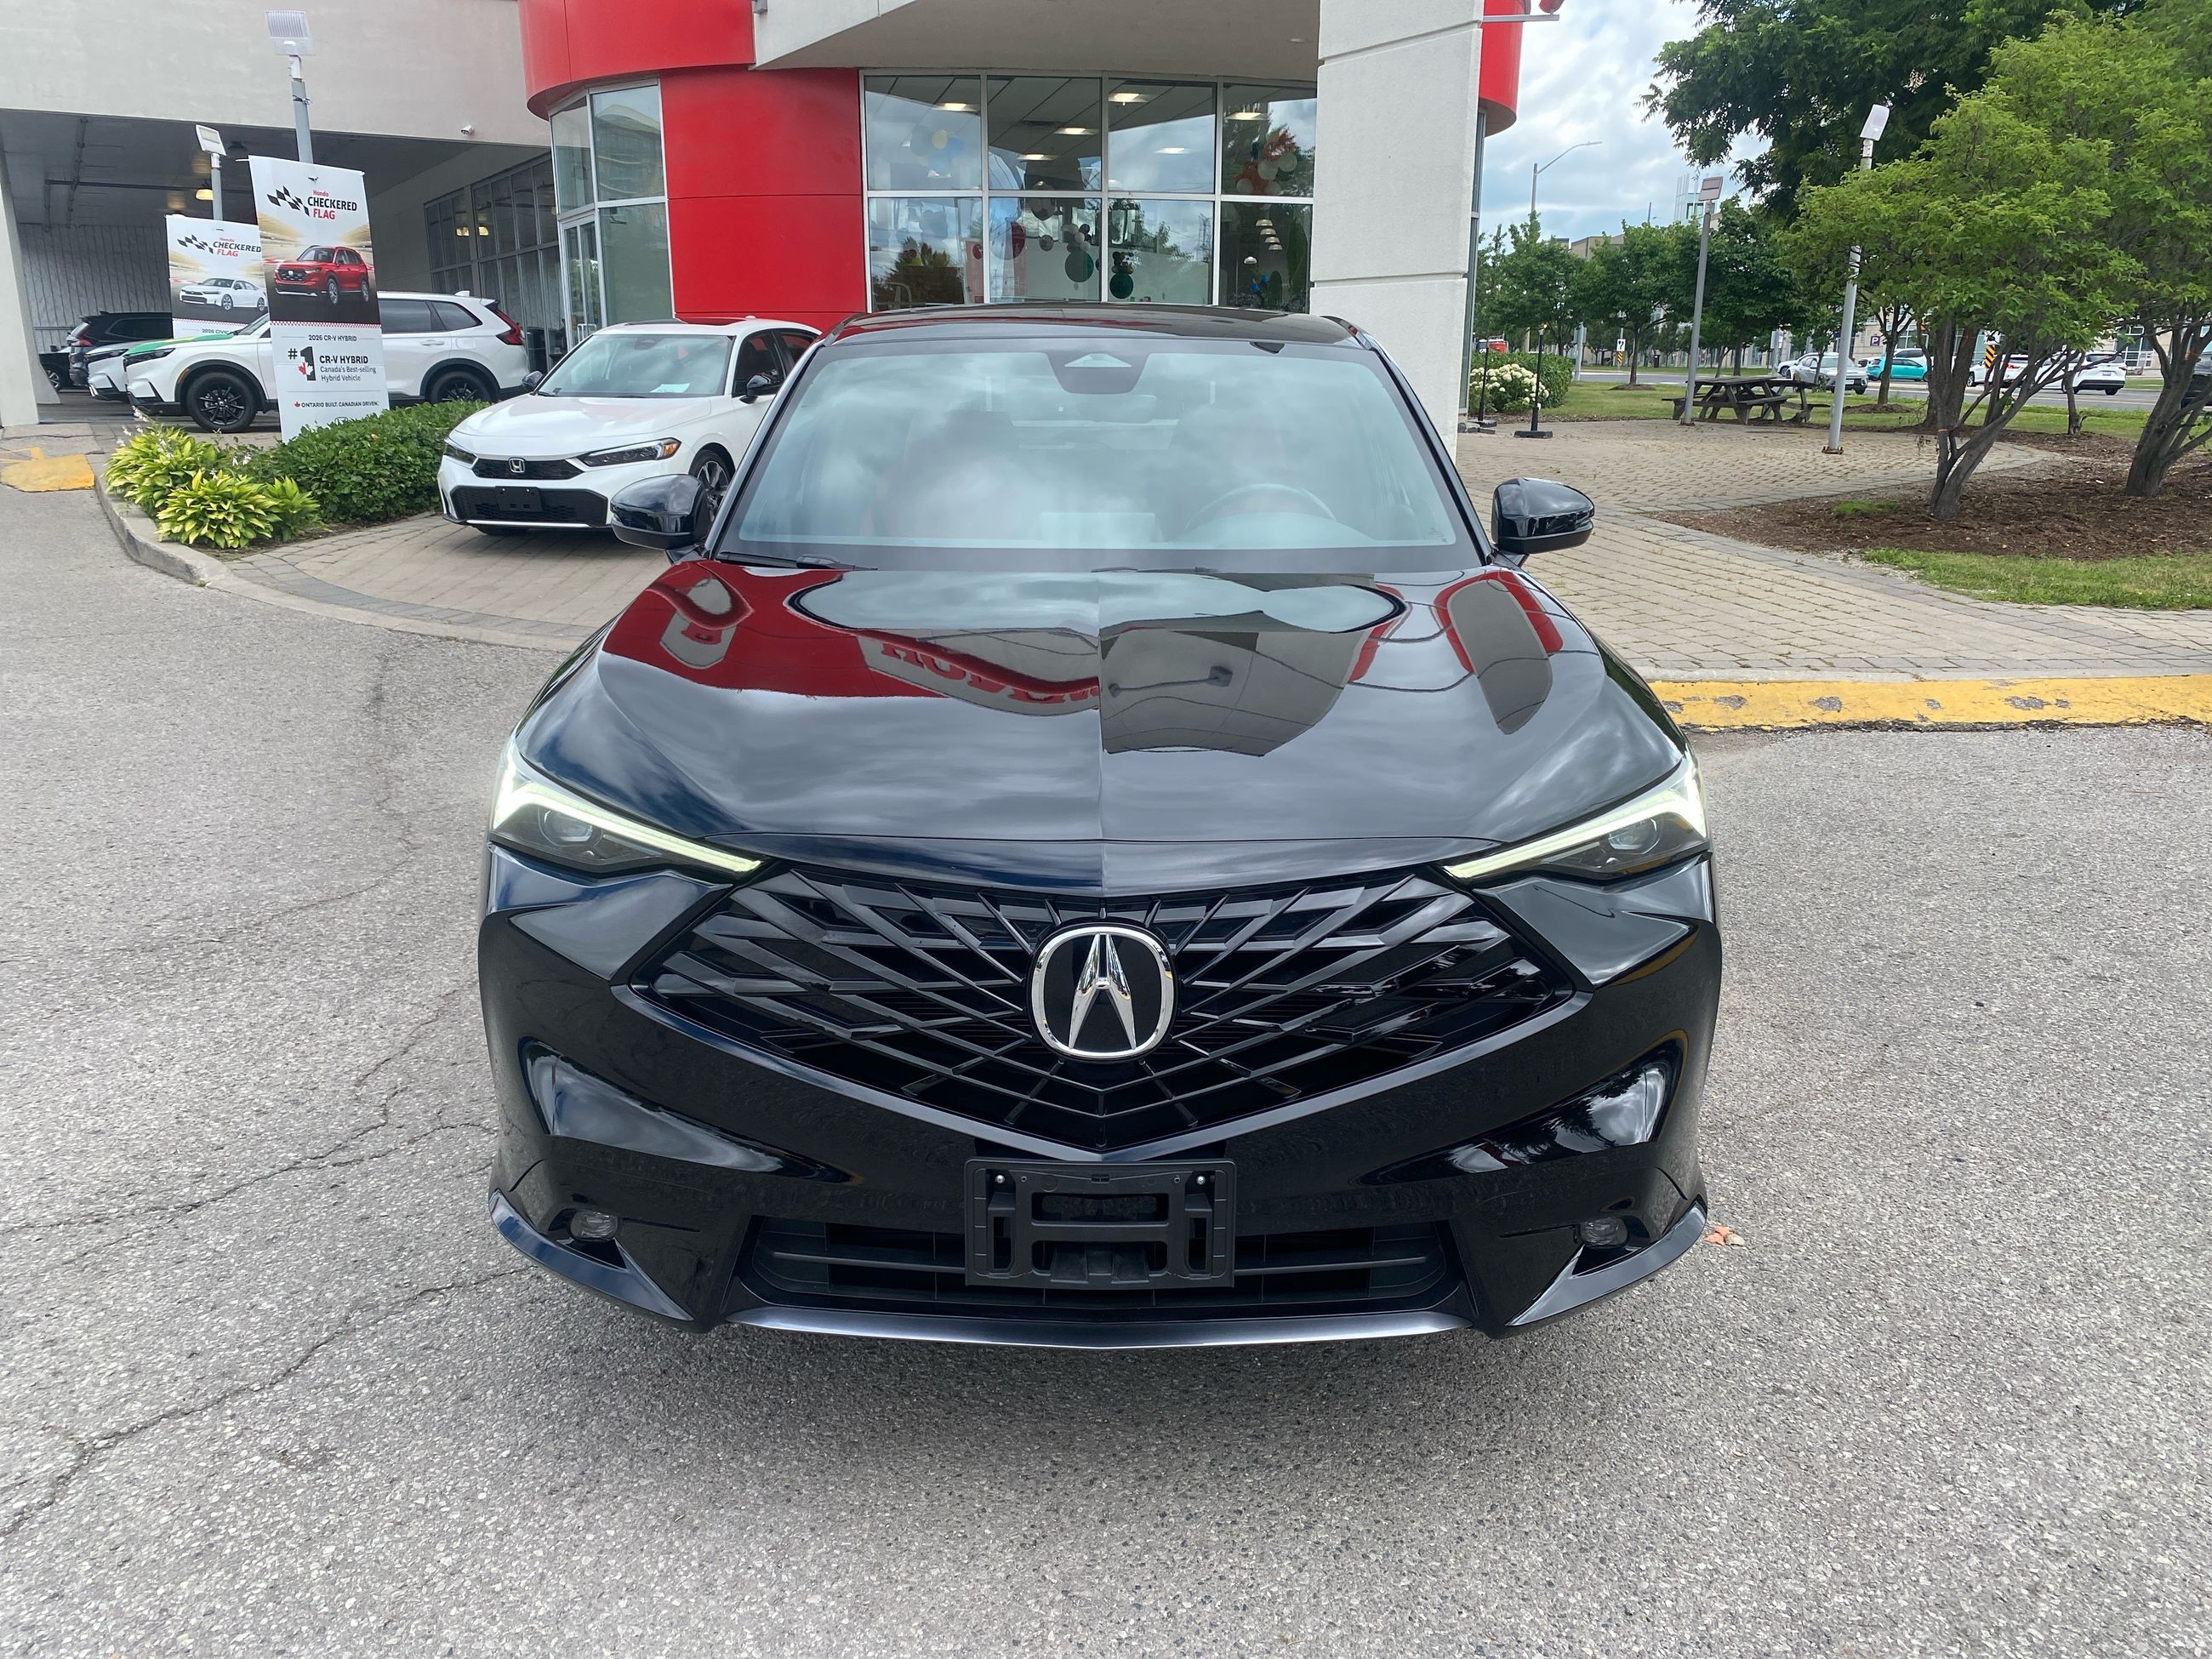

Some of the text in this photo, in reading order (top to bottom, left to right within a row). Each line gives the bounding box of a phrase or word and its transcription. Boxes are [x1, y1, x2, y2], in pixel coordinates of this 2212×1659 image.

[307, 197, 357, 212] CHECKERED
[313, 208, 335, 219] FLAG
[213, 241, 262, 253] CHECKERED
[319, 355, 368, 364] CR-V HYBRID
[346, 366, 377, 374] Best-selling
[321, 374, 340, 383] Hybrid
